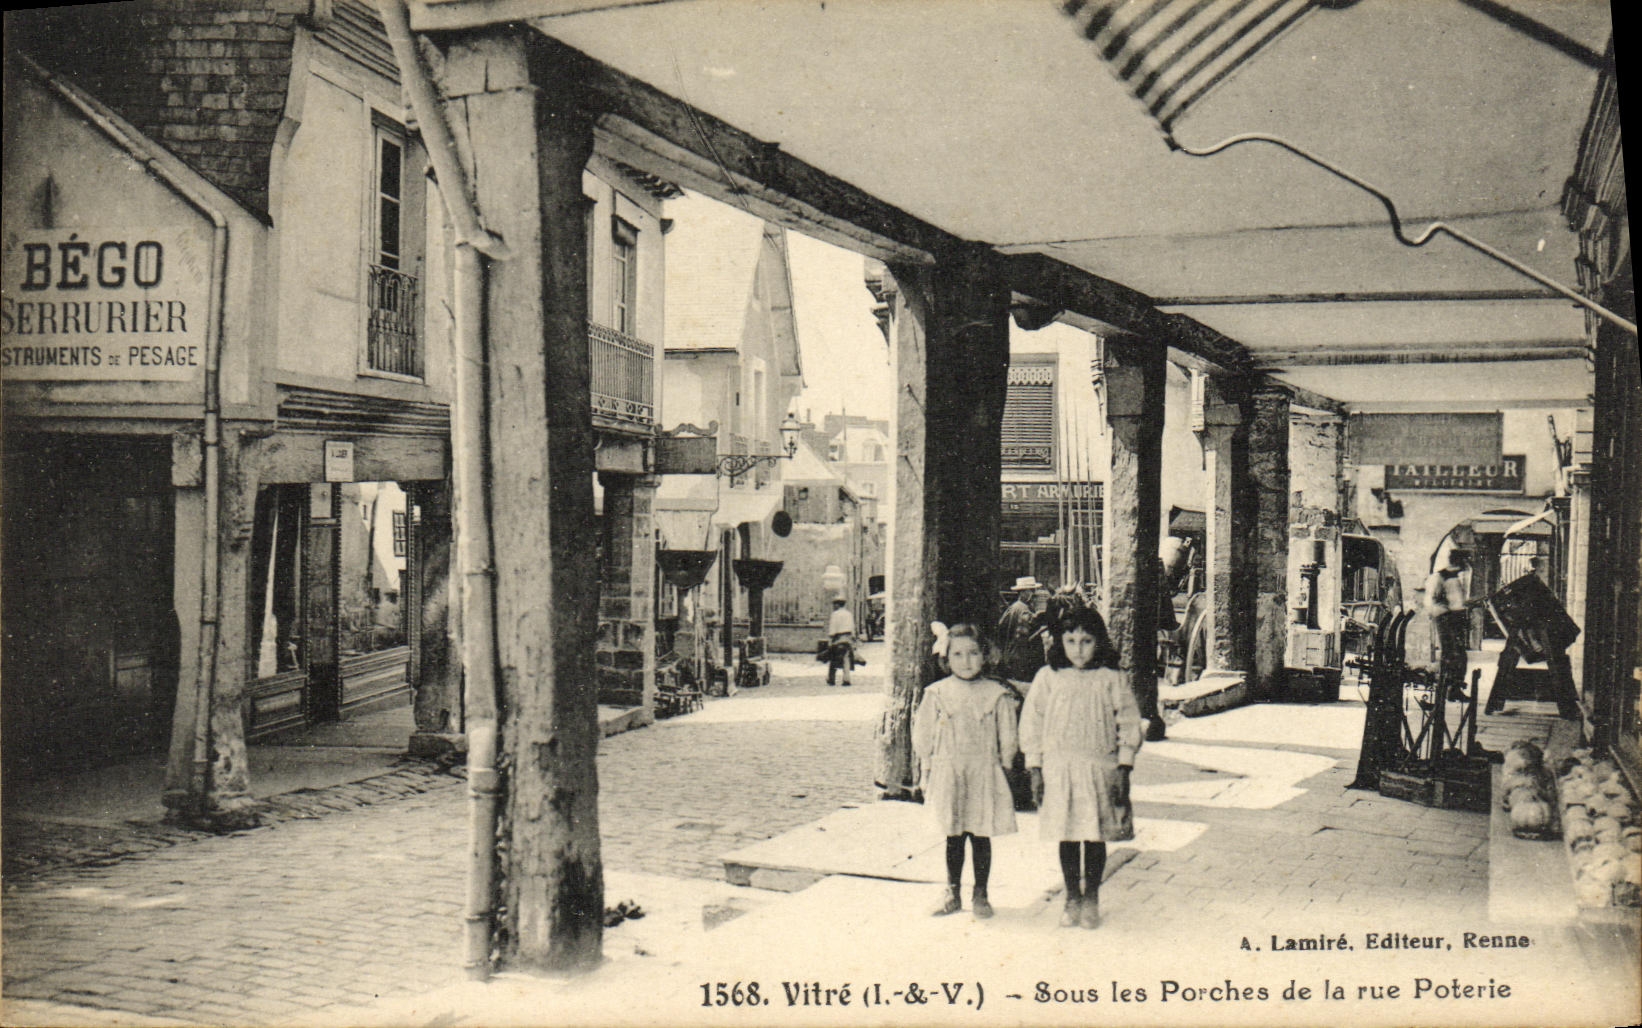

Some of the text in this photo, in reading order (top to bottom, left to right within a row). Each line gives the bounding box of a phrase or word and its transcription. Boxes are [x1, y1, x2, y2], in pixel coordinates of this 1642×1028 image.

[20, 233, 164, 291] BÉGO
[2, 297, 188, 336] SERRURIER
[128, 346, 198, 367] PESAGE
